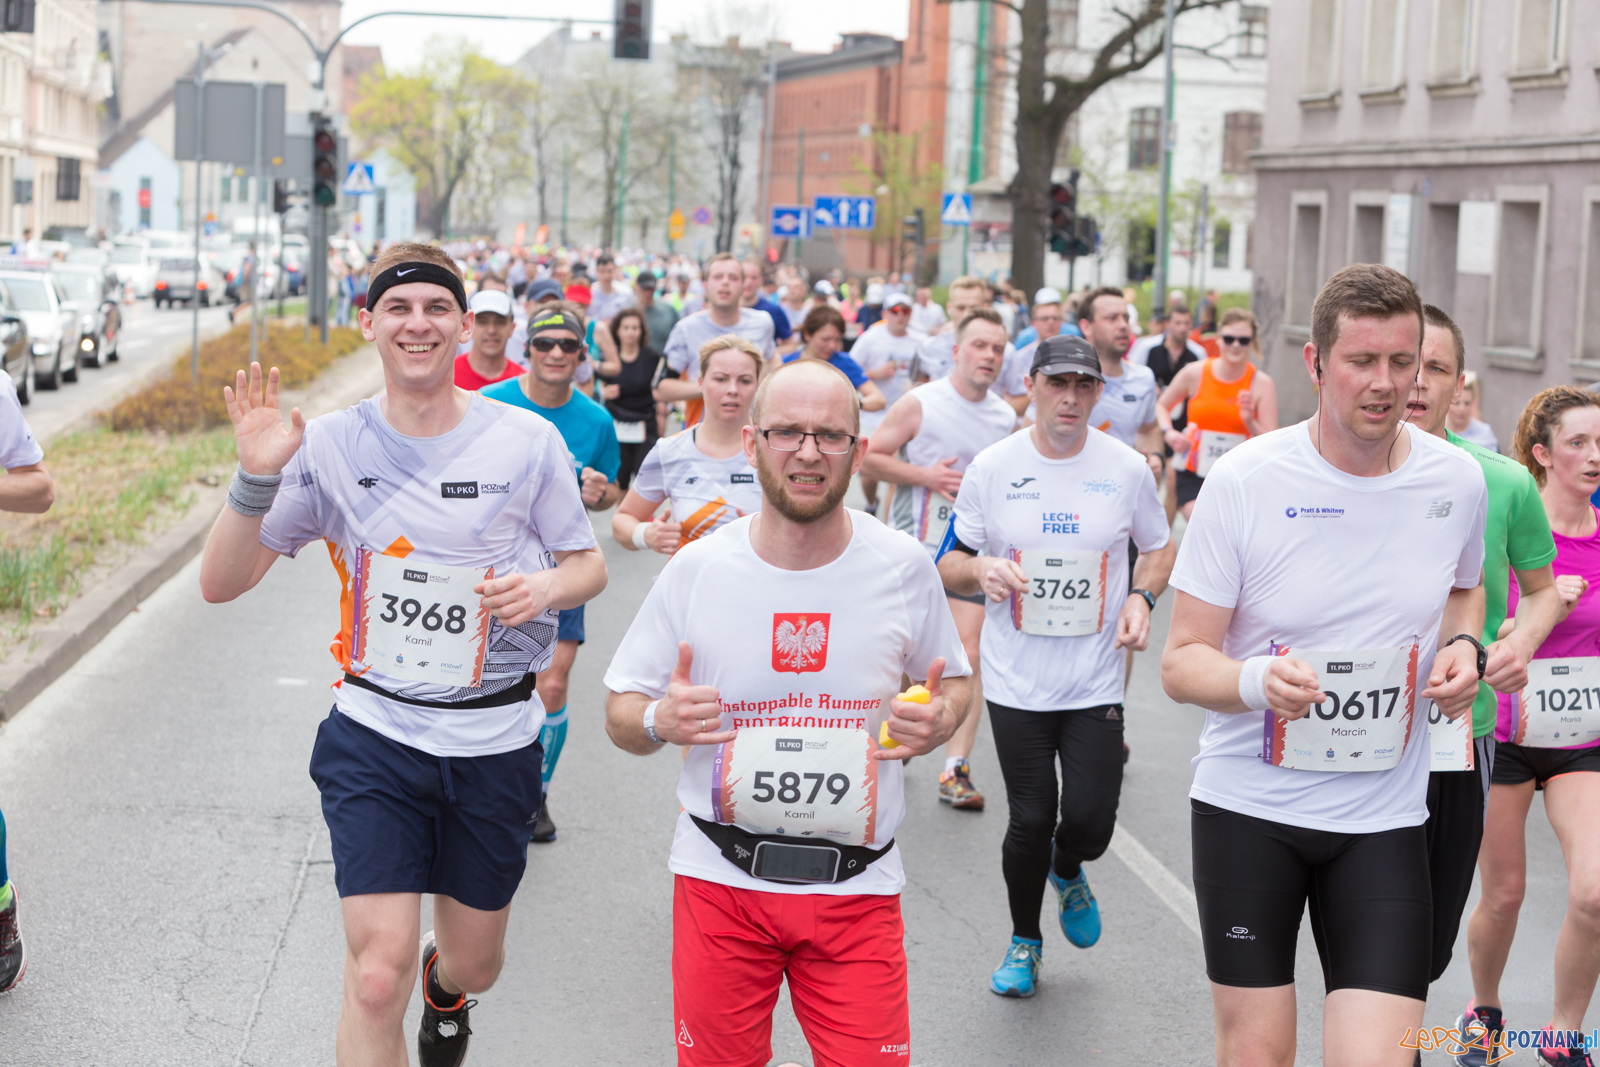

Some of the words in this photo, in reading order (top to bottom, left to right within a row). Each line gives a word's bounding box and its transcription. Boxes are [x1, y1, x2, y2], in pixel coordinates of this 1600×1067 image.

[457, 486, 475, 494] PKO
[1042, 512, 1073, 521] LECH
[1321, 507, 1345, 515] Whitney
[1042, 523, 1080, 534] FREE
[1033, 578, 1090, 599] 3762
[379, 592, 467, 634] 3968
[405, 635, 432, 646] Kamil
[818, 693, 882, 711] Runners
[1303, 686, 1401, 721] 0617
[1536, 685, 1600, 712] 10211
[1331, 728, 1367, 736] Marcin
[752, 770, 851, 805] 5879
[784, 810, 815, 819] Kamil
[1226, 932, 1256, 941] Kalenji
